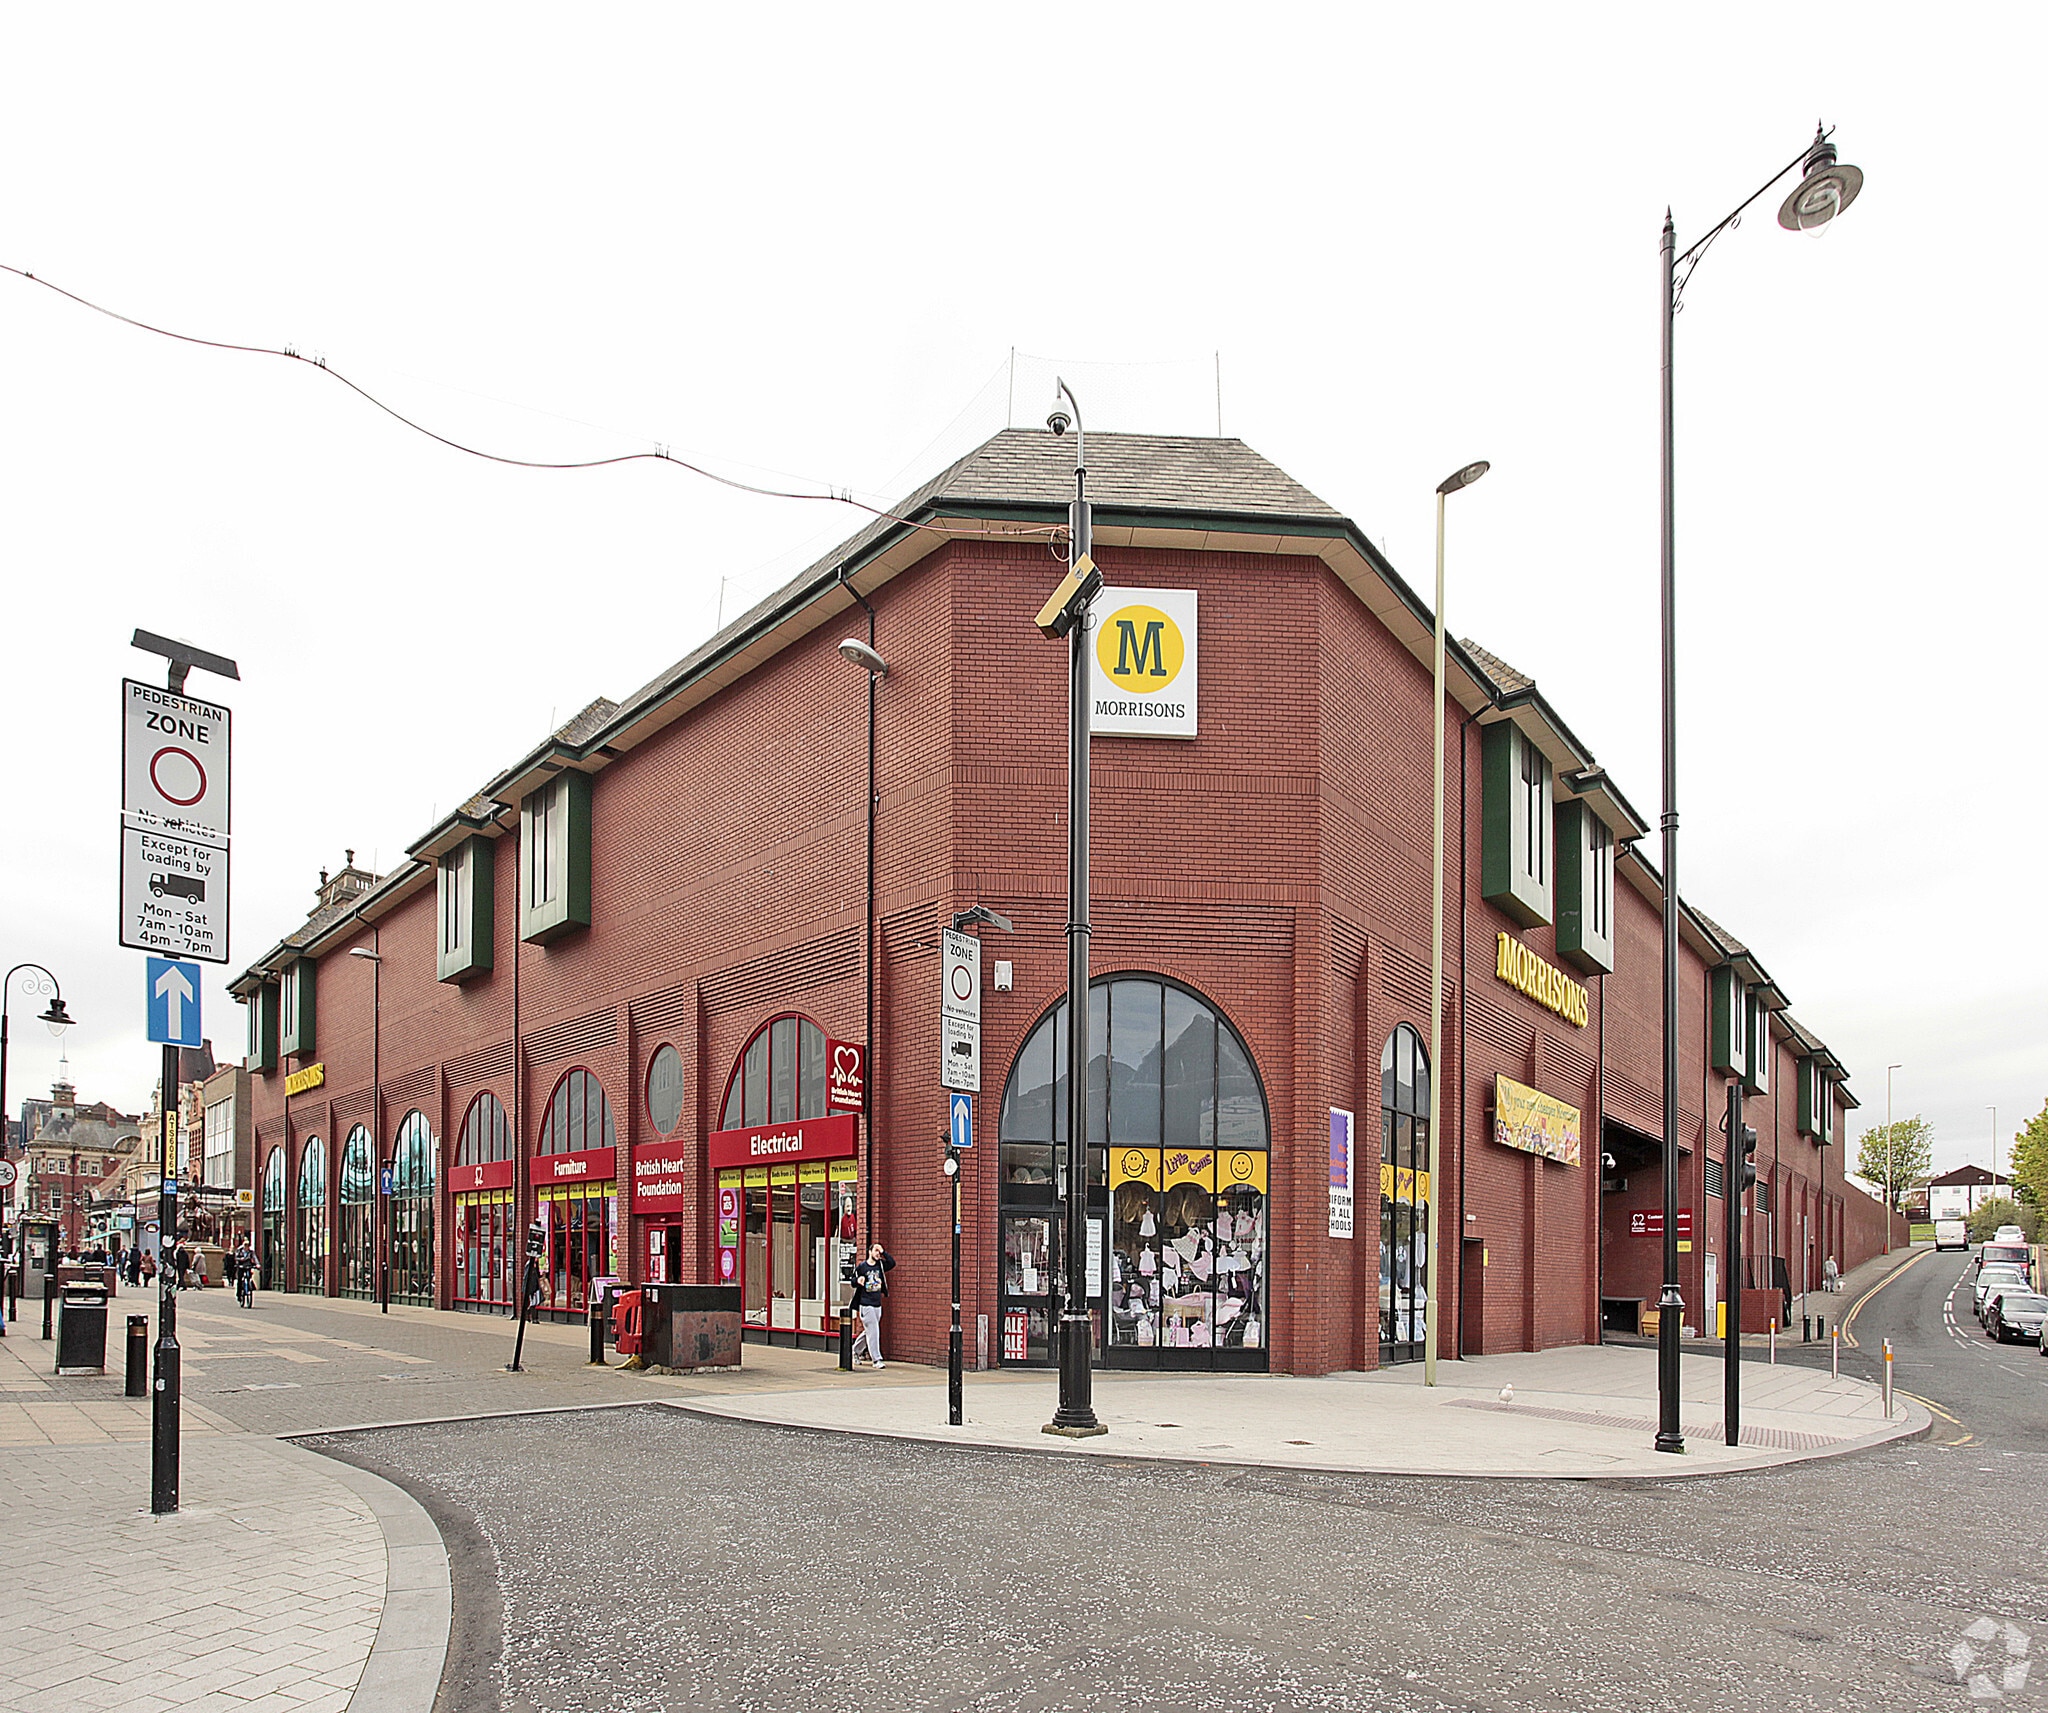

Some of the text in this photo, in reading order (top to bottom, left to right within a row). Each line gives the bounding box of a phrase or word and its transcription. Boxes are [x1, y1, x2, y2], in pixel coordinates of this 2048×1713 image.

[1113, 620, 1167, 676] M
[133, 686, 222, 722] PEDESTRIAN
[1095, 700, 1185, 718] MORRISONS
[146, 710, 209, 744] ZONE
[137, 808, 217, 839] No vehicles
[141, 835, 211, 861] Except for
[141, 849, 211, 876] loading by
[143, 902, 172, 918] Mon
[185, 911, 208, 926] Sat
[137, 915, 166, 931] 7am
[179, 923, 213, 941] 10am
[139, 930, 171, 946] 4pm
[183, 938, 212, 954] 7pm
[945, 930, 978, 948] PEDESTRIAN
[950, 943, 973, 962] ZONE
[1496, 930, 1588, 1029] MORRISONS
[947, 1003, 976, 1018] No vehicles
[948, 1019, 974, 1031] Except for
[948, 1027, 974, 1041] loading by
[947, 1058, 959, 1067] Mon
[964, 1062, 973, 1071] Sat
[831, 1086, 862, 1098] British Heart
[831, 1094, 862, 1107] Foundation
[750, 1129, 803, 1156] Electrical
[554, 1158, 587, 1176] Furniture
[635, 1157, 684, 1177] British Heart
[1165, 1152, 1213, 1176] Little Gems
[637, 1180, 682, 1197] Foundation
[1330, 1194, 1352, 1206] IFORM
[1338, 1208, 1351, 1219] ALL
[1330, 1219, 1352, 1231] HOOLS
[1004, 1316, 1024, 1333] ALE
[1004, 1334, 1024, 1351] ALE
